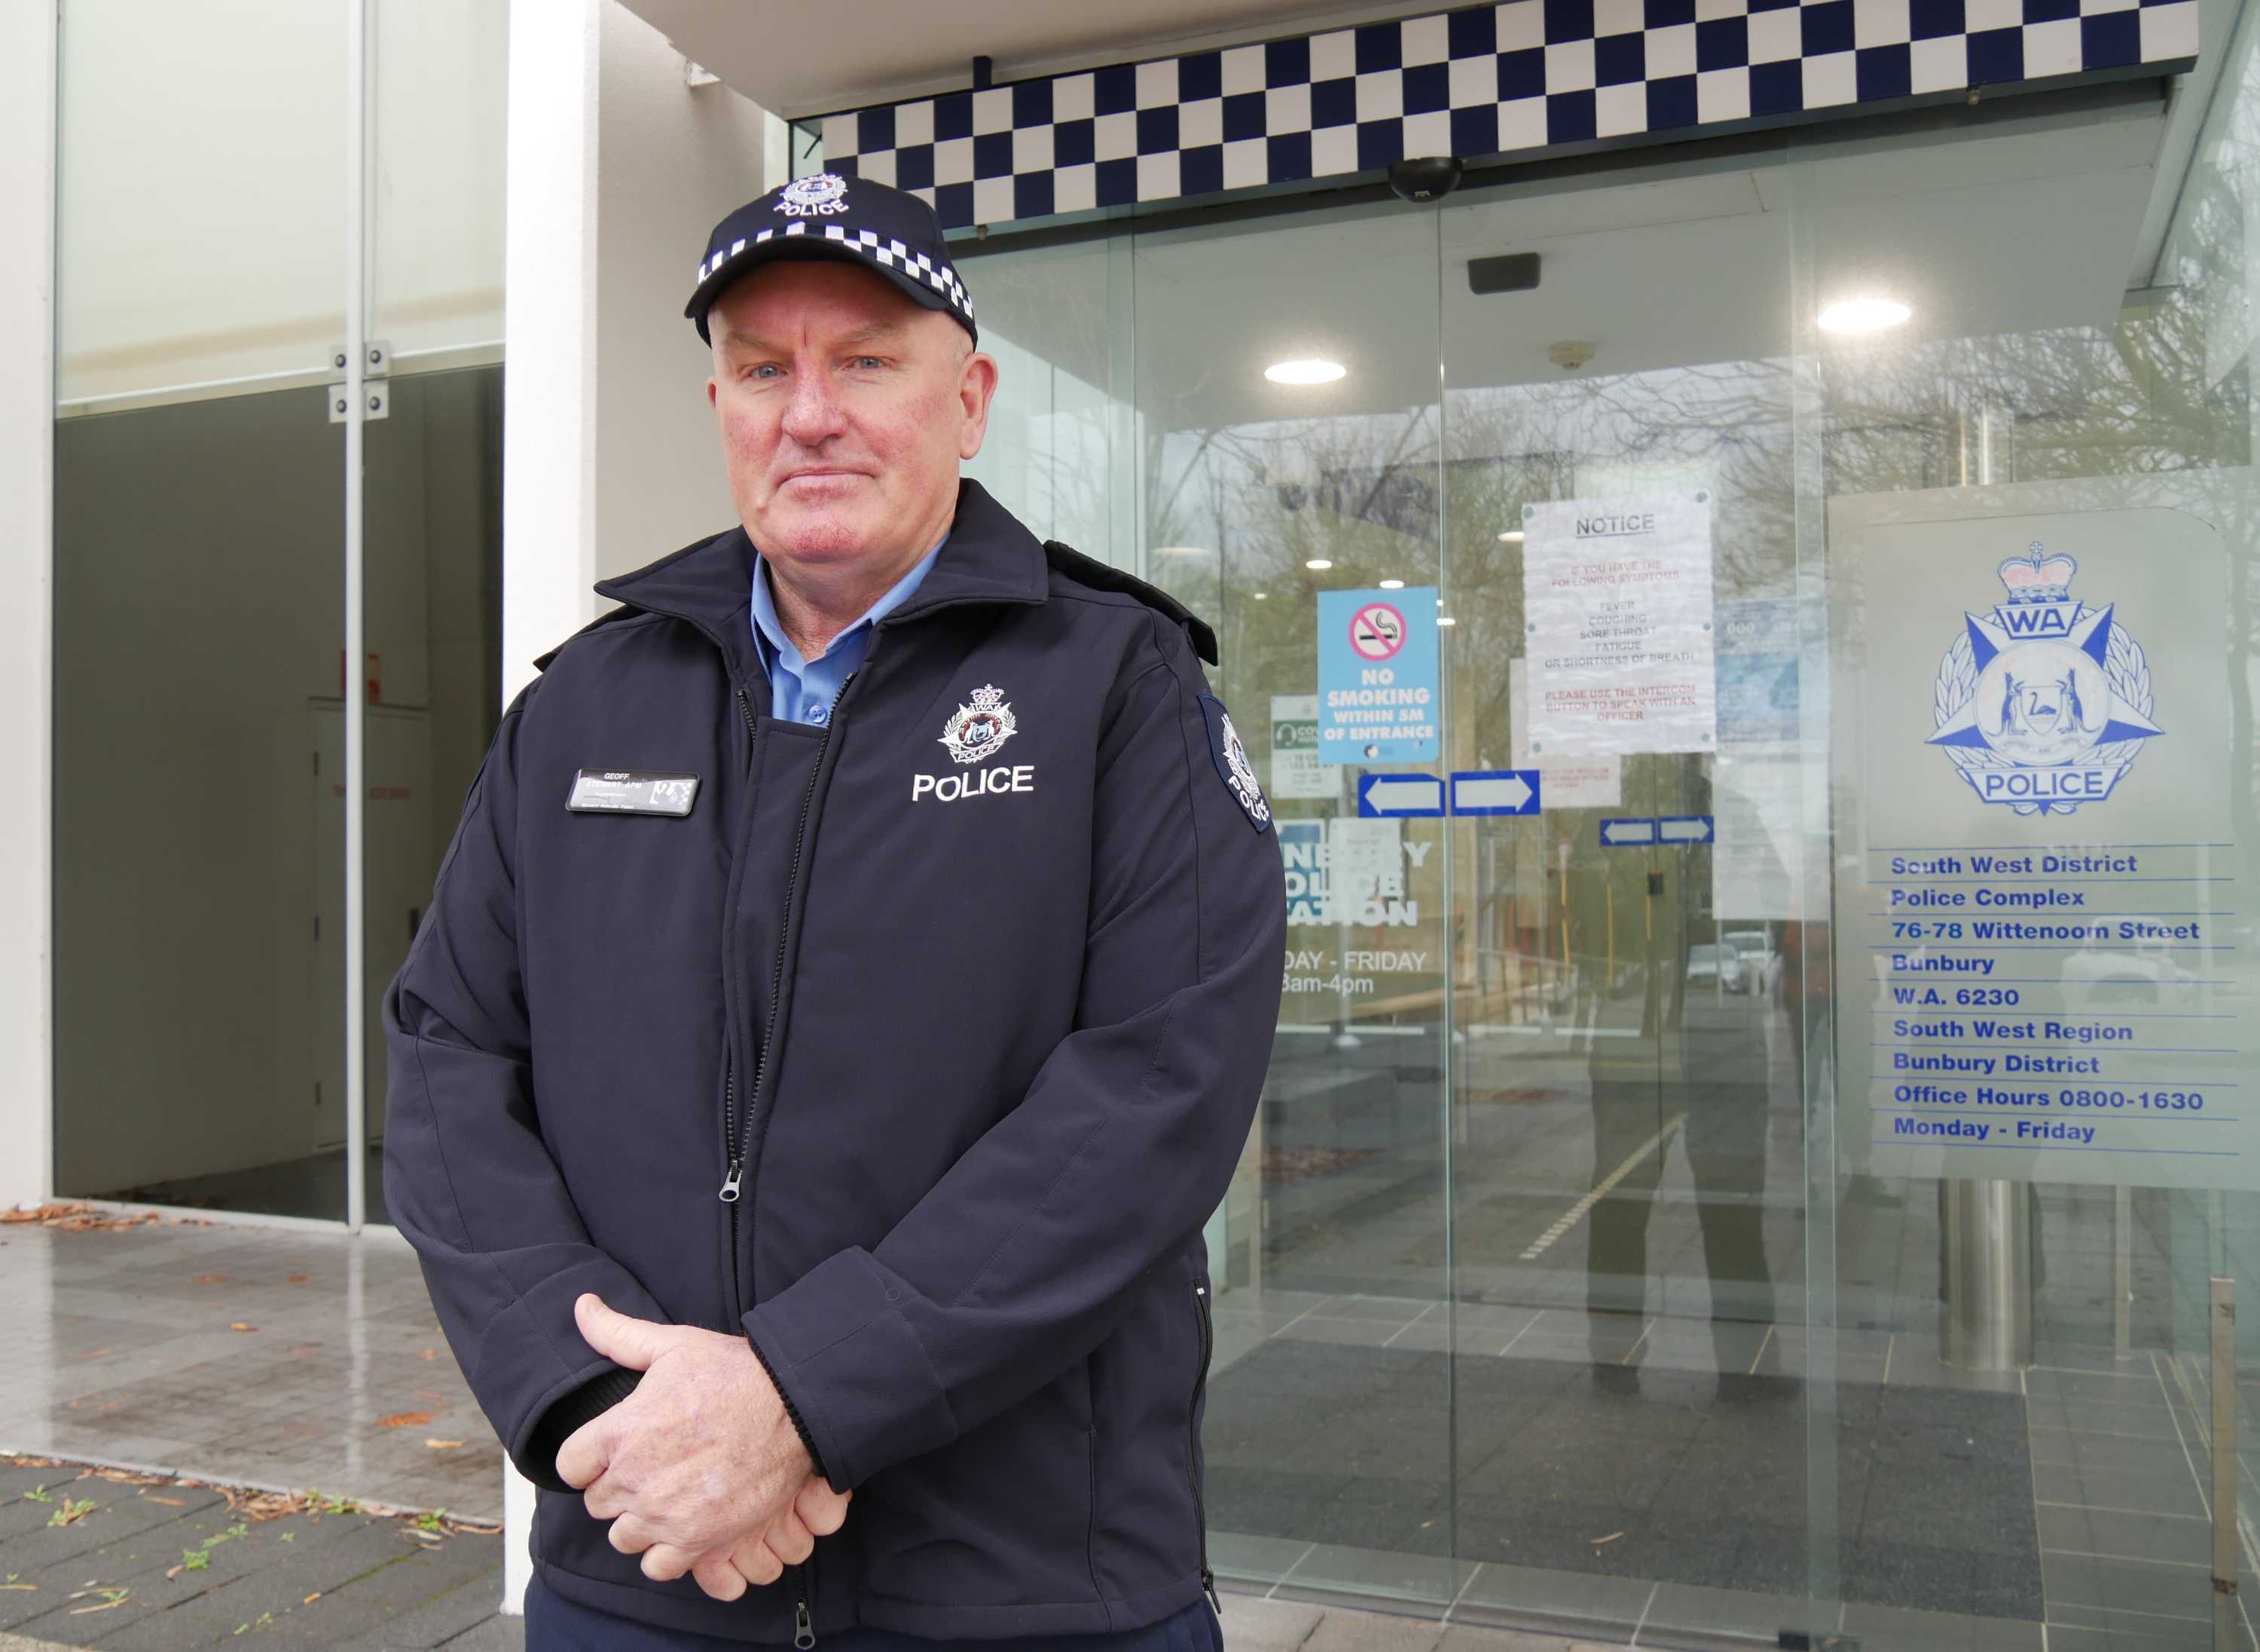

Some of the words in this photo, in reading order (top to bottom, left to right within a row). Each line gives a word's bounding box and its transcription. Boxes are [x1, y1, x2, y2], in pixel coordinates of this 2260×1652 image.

[774, 199, 849, 216] POLICE
[1576, 514, 1655, 536] NOTICE
[1584, 564, 1605, 574] YOU
[1609, 561, 1639, 572] HAVE
[1552, 576, 1615, 587] FOLLOWING
[1600, 601, 1635, 611] FEVER
[1589, 614, 1648, 626] COUGHING
[2006, 609, 2066, 634] WA
[1580, 628, 1609, 639] SORE
[1614, 626, 1657, 637] THROAT
[1595, 640, 1642, 651] FATIGUE
[1545, 658, 1561, 668] OR
[1564, 655, 1628, 667] SHORTNESS
[1632, 654, 1645, 664] OF
[1649, 652, 1694, 662] BREATH
[1361, 667, 1394, 686] NO
[1327, 687, 1430, 707] SMOKING
[1545, 689, 1587, 700] PLEASE
[1590, 689, 1611, 698] USE
[1615, 687, 1635, 697] THE
[1638, 684, 1696, 695] INTERCOM
[1546, 701, 1590, 712] BUTTON
[1593, 701, 1607, 710] TO
[1611, 698, 1645, 709] SPEAK
[1648, 697, 1677, 707] WITH
[1681, 696, 1696, 707] AN
[1333, 709, 1394, 723] WITHIN
[1598, 710, 1644, 721] OFFICER
[1324, 727, 1345, 740] OF
[1349, 725, 1434, 740] ENTRANCE
[957, 745, 995, 759] POLICE
[912, 765, 1035, 802] POLICE
[1986, 771, 2103, 798] POLICE
[1228, 775, 1269, 822] POLICE
[1891, 857, 1962, 875] South
[1971, 857, 2032, 874] West
[2042, 856, 2137, 872] District
[1891, 890, 1965, 906] Police
[1975, 889, 2084, 908] Complex
[1892, 922, 1963, 939] 76-78
[1972, 922, 2109, 939] Wittenoom
[2119, 921, 2199, 939] Street
[1284, 950, 1324, 970] DAY
[1344, 951, 1427, 972] FRIDAY
[1892, 954, 1995, 975] Bunbury
[1893, 988, 1946, 1005] W.A.
[1956, 988, 2020, 1006] 6230
[1893, 1020, 1964, 1037] South
[1973, 1021, 2036, 1039] West
[2045, 1021, 2133, 1043] Region
[1893, 1052, 1996, 1075] Bunbury
[2005, 1055, 2100, 1073] District
[1895, 1085, 1967, 1104] Office
[1977, 1087, 2049, 1106] Hours
[2060, 1089, 2204, 1110] 0800-1630
[1894, 1117, 1989, 1141] Monday
[2017, 1120, 2095, 1144] Friday
